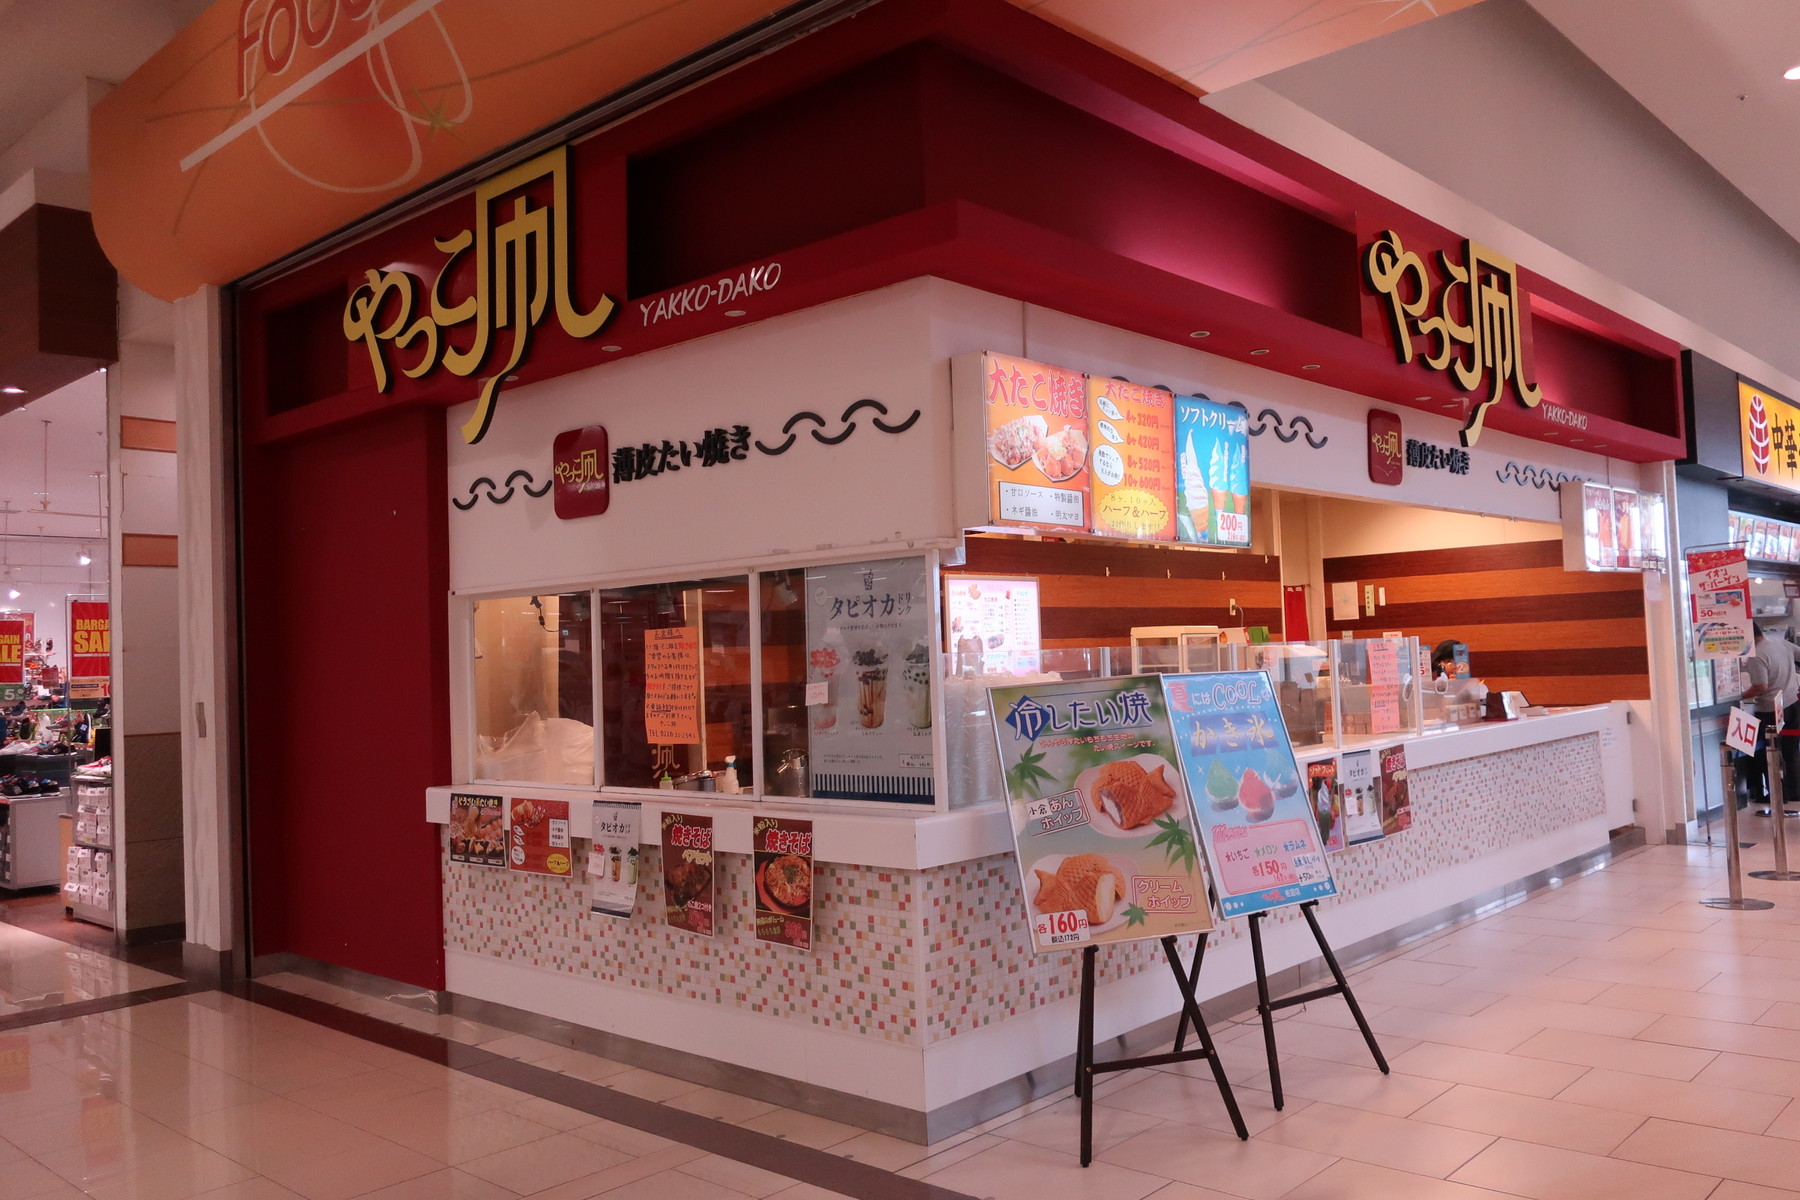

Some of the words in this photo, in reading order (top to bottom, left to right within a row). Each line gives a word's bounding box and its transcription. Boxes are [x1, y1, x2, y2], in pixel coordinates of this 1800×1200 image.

[639, 262, 782, 326] YAKKO-DAKO
[989, 359, 1086, 418] 大たこ焼き
[1105, 381, 1166, 408] 大たこ焼き
[1180, 405, 1247, 434] ソフトクリーム
[1542, 403, 1588, 431] YAKKO-DAKO
[612, 424, 751, 484] 薄皮たい焼き
[1406, 438, 1470, 475] 薄皮たい焼き
[1772, 413, 1800, 480] 中華
[1011, 487, 1043, 498] 甘口ソース
[1220, 513, 1243, 531] 200円
[1706, 568, 1729, 579] イオン
[830, 593, 895, 620] タピオカ
[1008, 691, 1154, 741] 冷したい焼
[1193, 714, 1275, 750] かき氷
[1732, 717, 1756, 746] 入口
[1041, 807, 1083, 830] ホイップ
[671, 824, 713, 849] 焼きそば
[765, 829, 812, 854] 焼きそば
[1137, 880, 1184, 894] クリーム
[1147, 895, 1193, 909] ホイップ
[1037, 911, 1088, 935] 各160円
